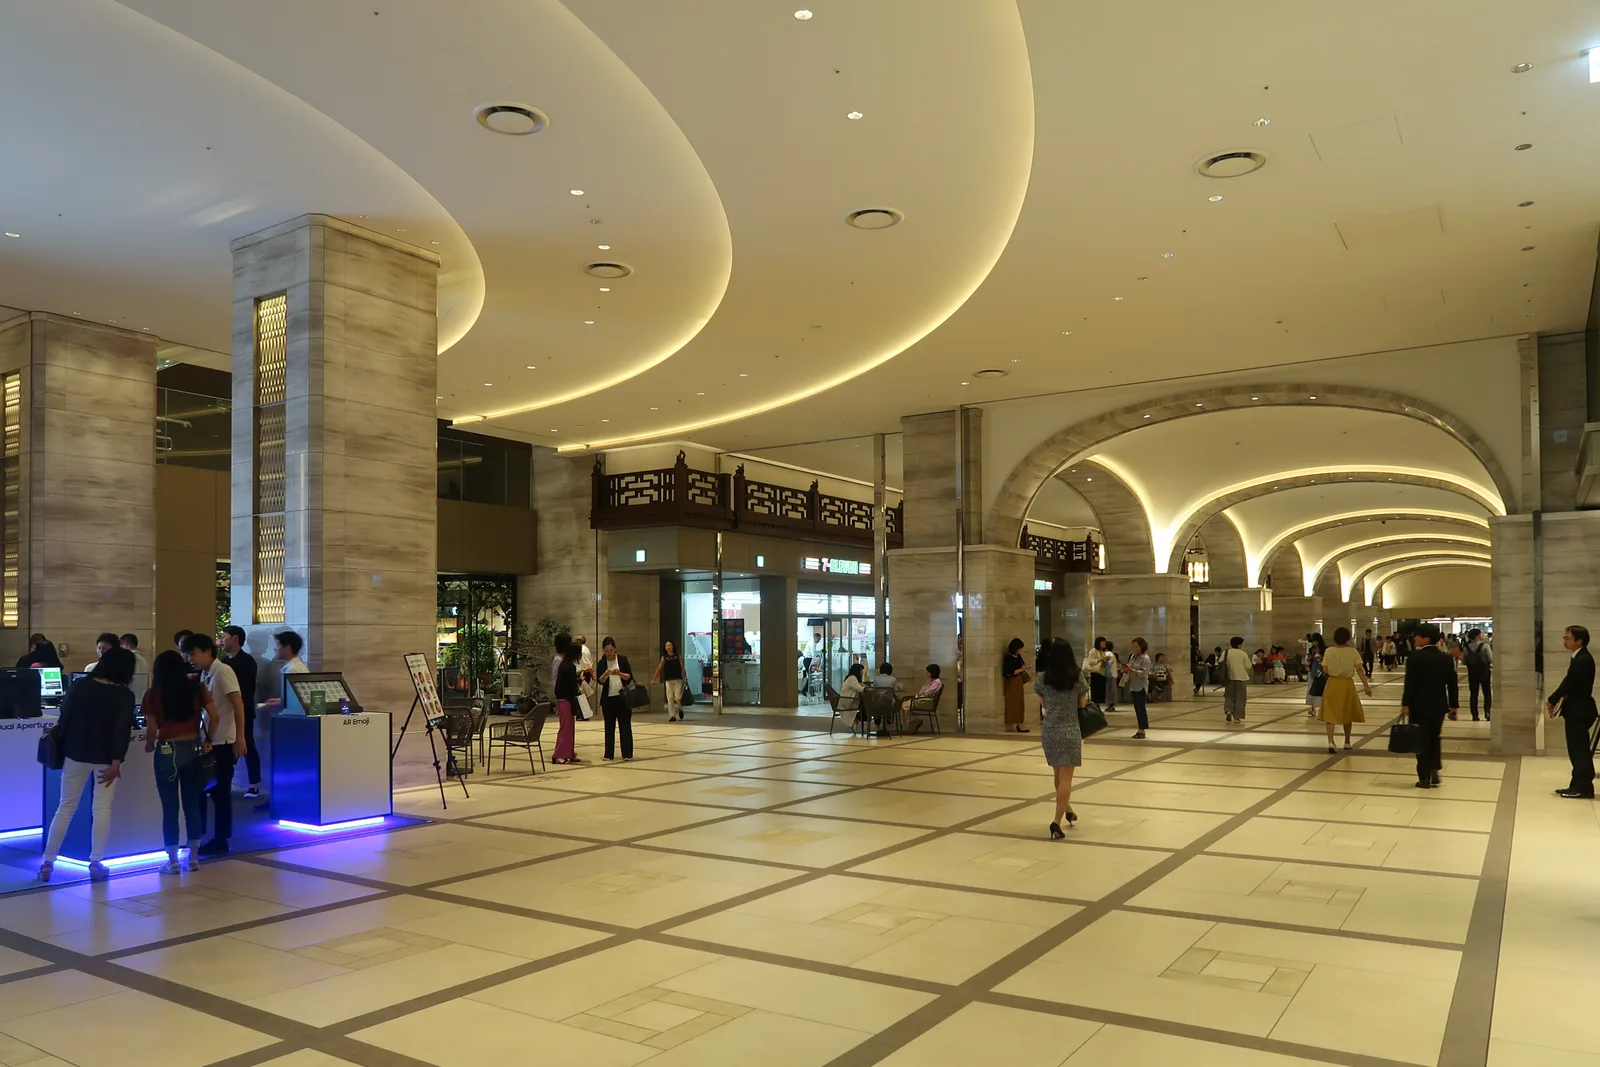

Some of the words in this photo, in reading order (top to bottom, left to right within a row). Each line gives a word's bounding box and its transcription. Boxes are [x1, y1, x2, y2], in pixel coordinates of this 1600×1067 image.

[0, 723, 15, 731] ual
[16, 721, 55, 732] Aperture
[342, 718, 352, 726] AR
[352, 716, 370, 727] Emoji
